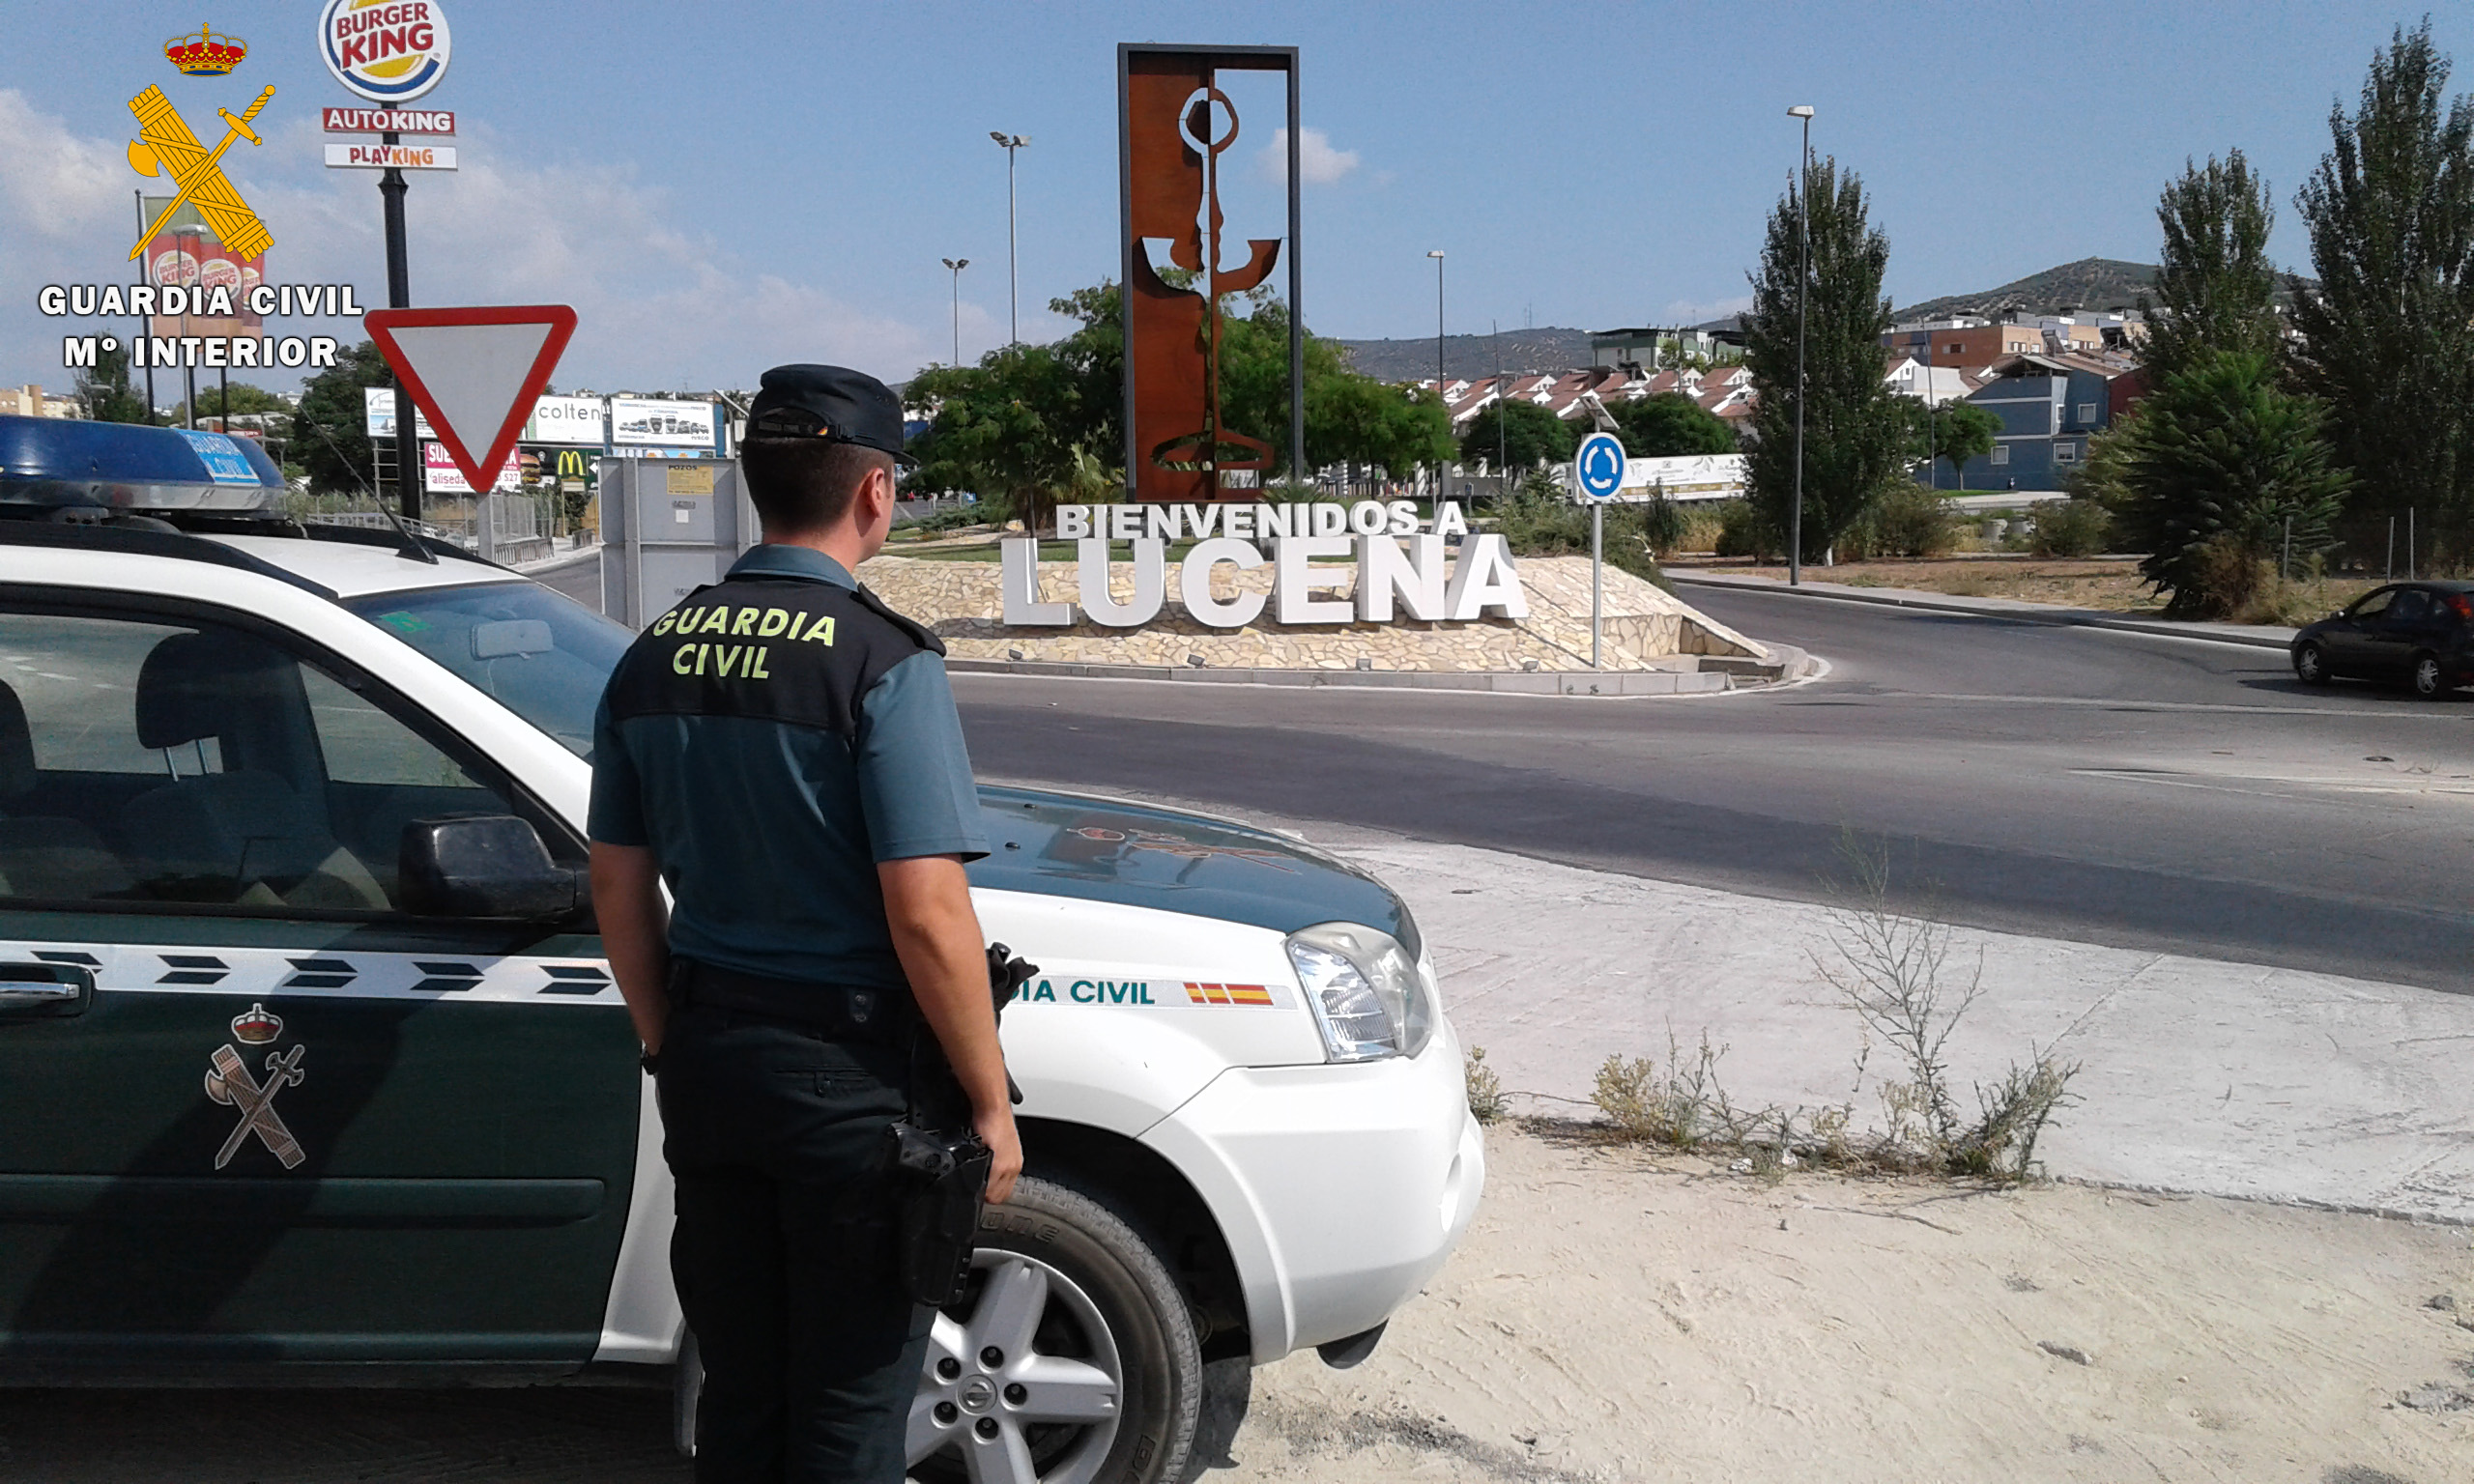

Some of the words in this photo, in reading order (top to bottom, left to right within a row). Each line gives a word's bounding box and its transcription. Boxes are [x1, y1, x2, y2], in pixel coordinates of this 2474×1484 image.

[336, 2, 429, 40] BURGER
[341, 22, 434, 69] KING
[1055, 499, 1420, 540] BIENVENIDOS
[1430, 500, 1468, 535] A
[1001, 533, 1530, 628] LUCENA
[653, 606, 836, 647] GUARDIA
[673, 642, 769, 679] CIVIL
[1070, 980, 1156, 1005] CIVIL
